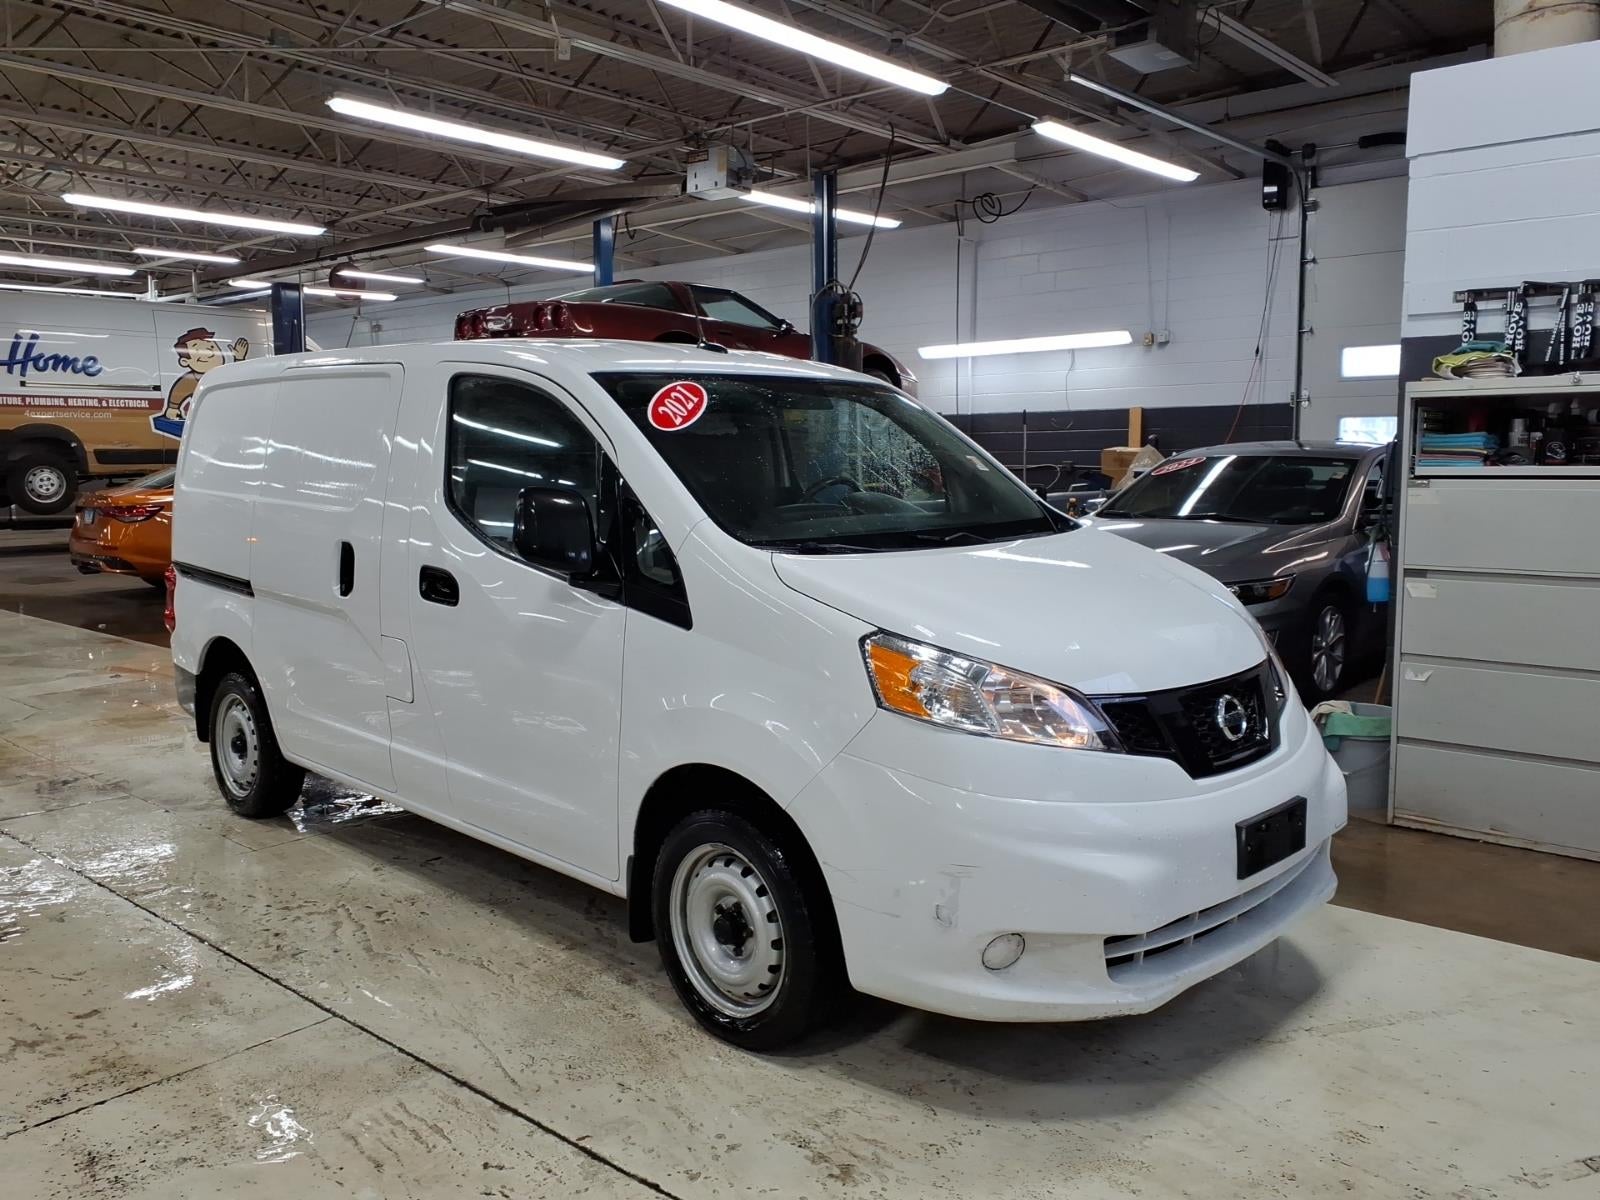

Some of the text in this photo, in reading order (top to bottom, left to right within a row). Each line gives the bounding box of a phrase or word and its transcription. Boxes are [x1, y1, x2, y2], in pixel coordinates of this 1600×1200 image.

[1505, 302, 1523, 346] HOVE
[1571, 303, 1585, 348] HOVE
[1, 333, 103, 377] Home
[25, 397, 67, 408] PLUMBING,
[68, 398, 101, 408] HEATING,
[108, 400, 150, 408] ELECTRICAL
[658, 385, 699, 426] 2021
